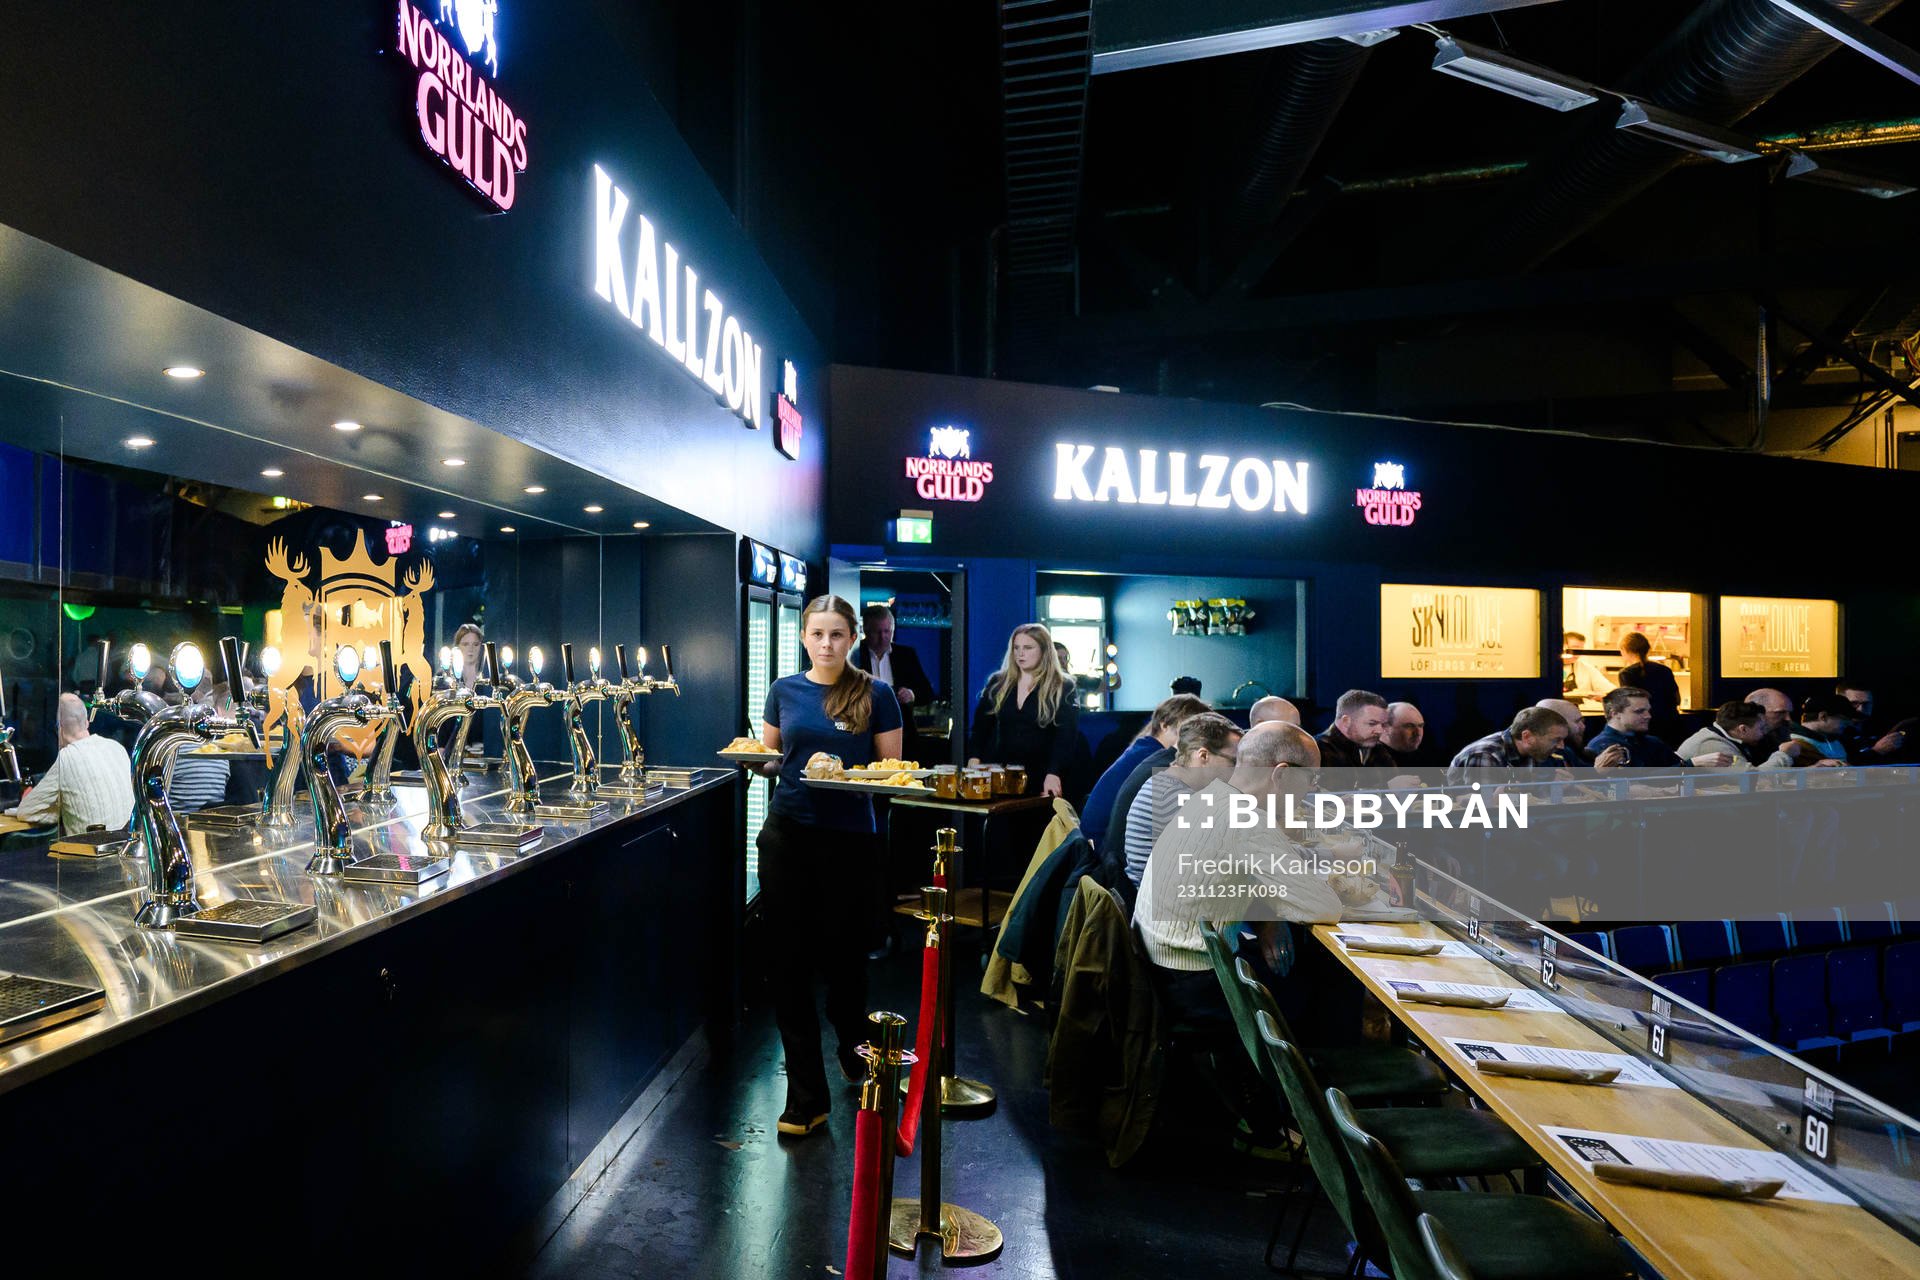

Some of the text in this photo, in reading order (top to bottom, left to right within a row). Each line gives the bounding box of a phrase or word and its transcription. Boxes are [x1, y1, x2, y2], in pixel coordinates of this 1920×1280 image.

[399, 0, 528, 171] NORRLANDS
[417, 71, 516, 210] GULD
[594, 163, 762, 430] KALLZON
[906, 457, 993, 483] NORRLANDS
[1054, 443, 1309, 515] KALLZON
[916, 474, 984, 502] GULD
[1356, 488, 1422, 510] NORRLANDS
[1364, 503, 1415, 526] GULD
[1470, 916, 1478, 939] 63
[1543, 960, 1554, 989] 62
[1652, 1024, 1665, 1057] 61
[1805, 1115, 1829, 1159] 60
